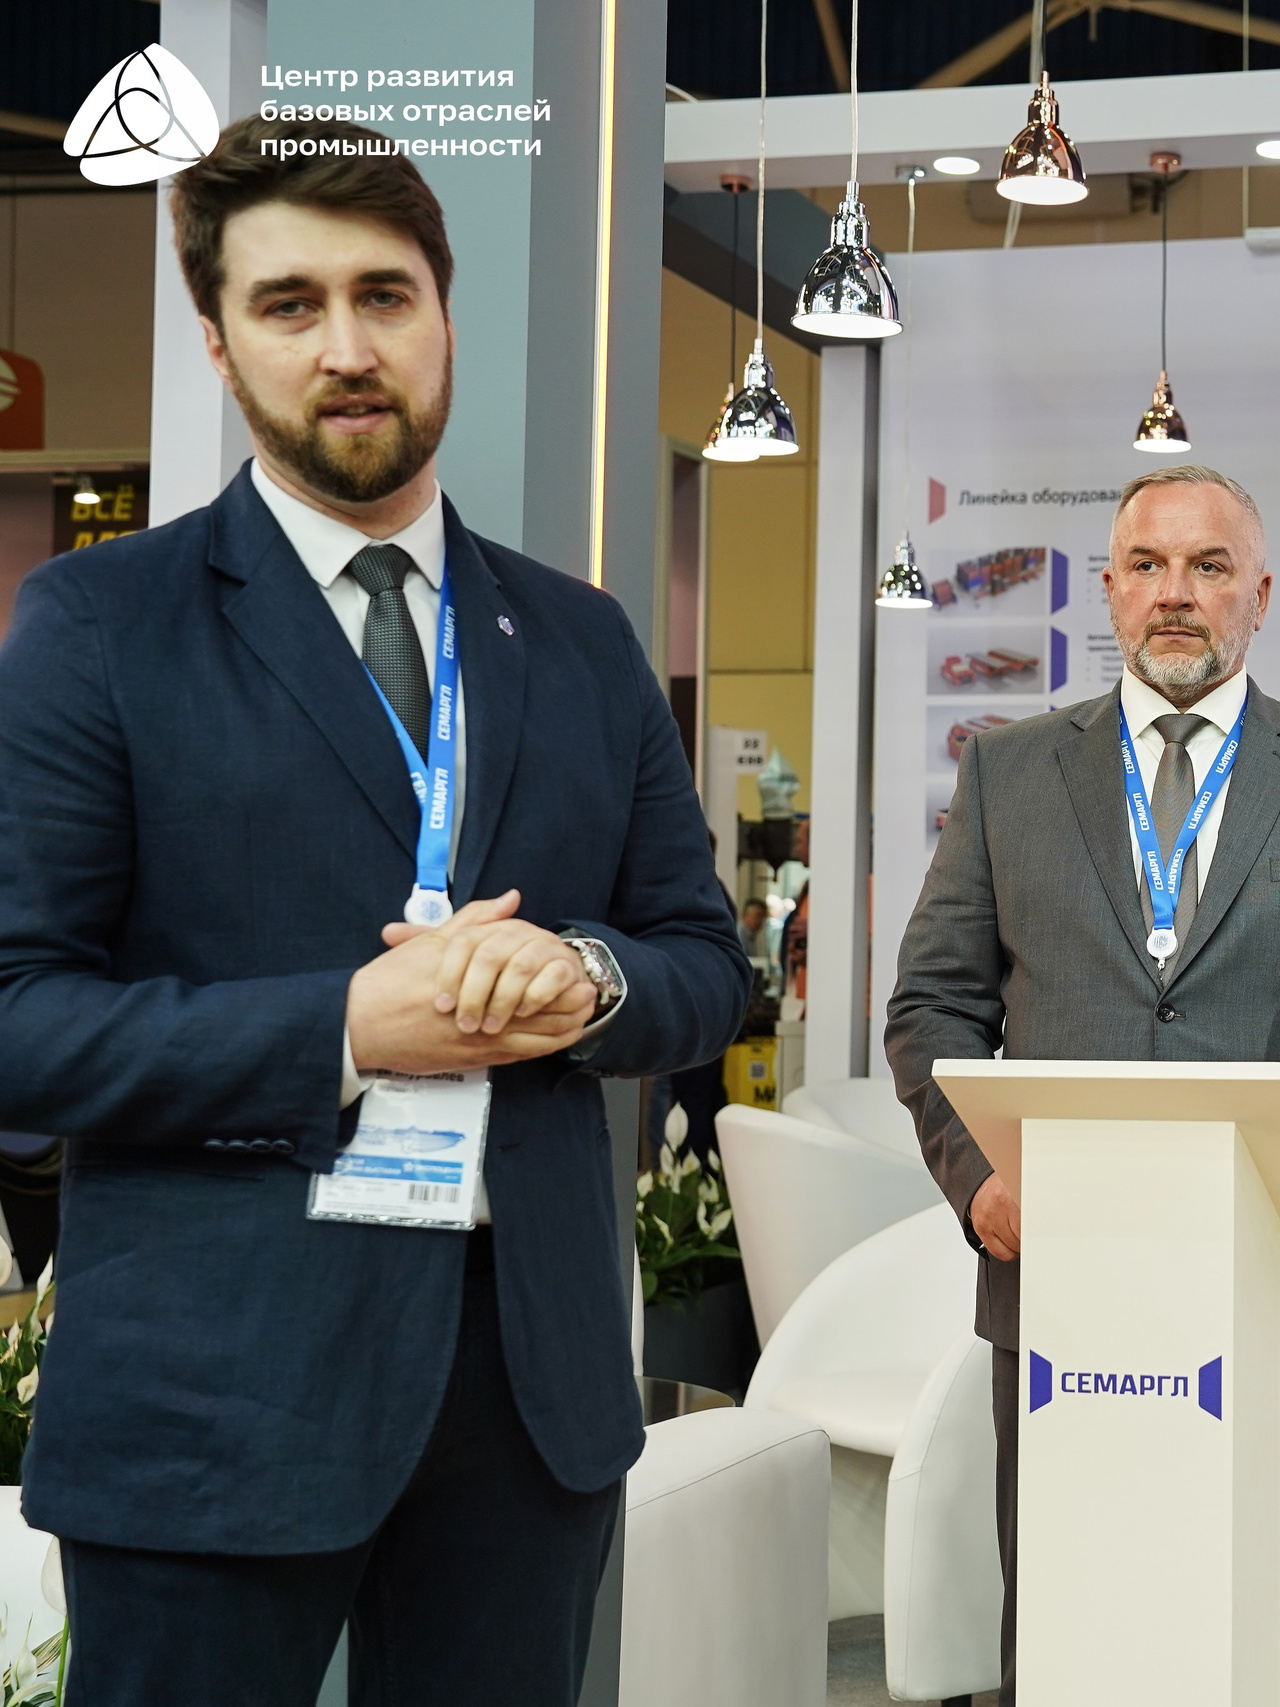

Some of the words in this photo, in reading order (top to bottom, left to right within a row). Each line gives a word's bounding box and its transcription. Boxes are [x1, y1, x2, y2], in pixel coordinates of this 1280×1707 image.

[958, 489, 1028, 506] Линейка
[442, 604, 456, 660] СЕМАРГЛ
[437, 684, 452, 741] СЕМАРГЛ
[1215, 739, 1238, 774] СЕМАРГЛ
[429, 767, 449, 830] СЕМАРГЛ
[1132, 792, 1150, 831] СЕМАРГЛ
[1188, 790, 1212, 830] СЕМАРГЛ
[1147, 851, 1164, 891] СЕМАРГЛ
[1168, 848, 1184, 894] СЕМАРГЛ
[1061, 1372, 1188, 1397] СЕМАРГЛ
